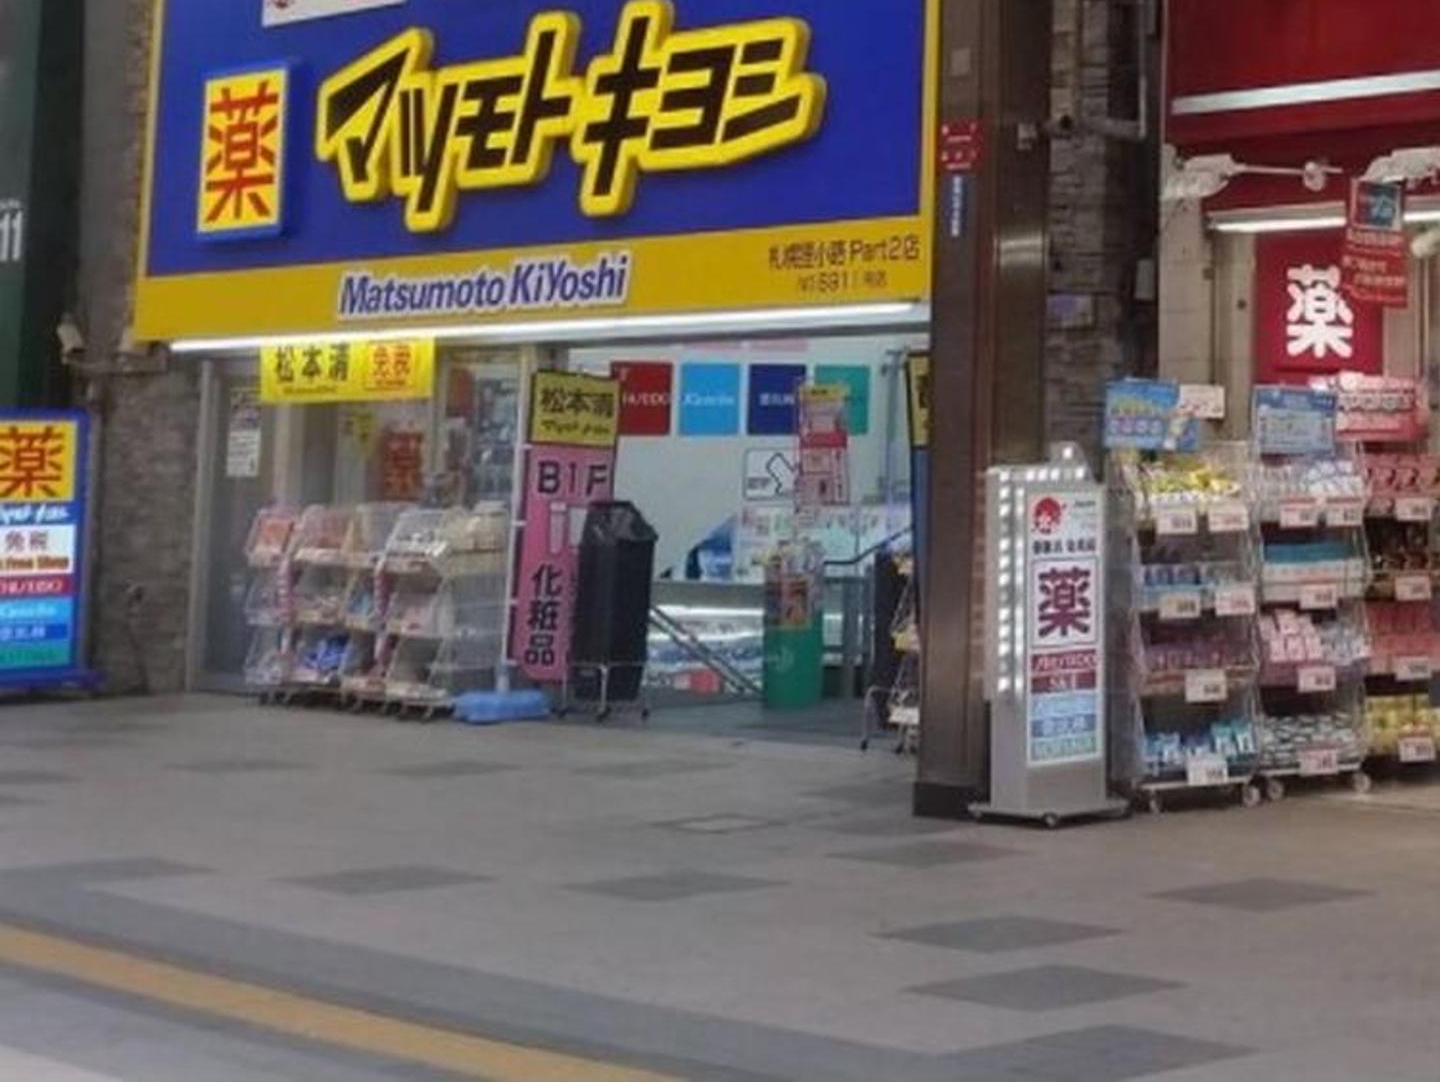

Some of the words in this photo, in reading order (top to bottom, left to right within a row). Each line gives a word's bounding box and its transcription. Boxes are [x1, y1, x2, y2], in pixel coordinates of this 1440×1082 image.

[205, 78, 279, 224] 薬
[318, 3, 818, 225] マツモトキヨシ
[339, 268, 507, 317] Matsumoto
[1286, 263, 1354, 359] 薬
[0, 425, 64, 499] 薬
[537, 460, 608, 496] B1F
[523, 563, 564, 667] 化粧品
[1038, 566, 1091, 638] 薬
